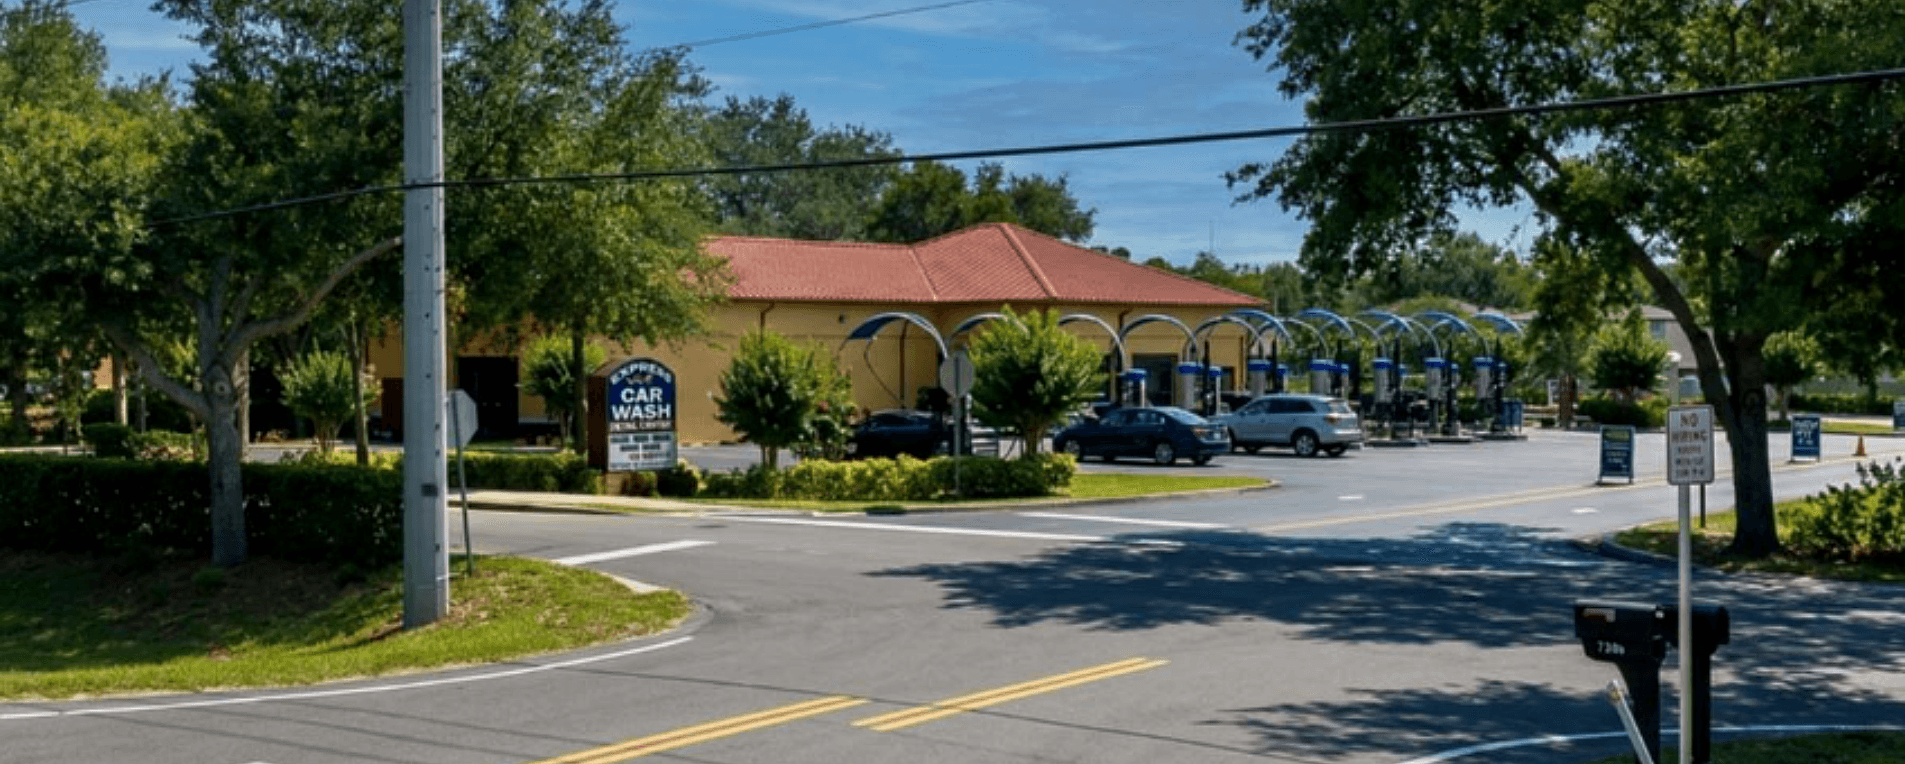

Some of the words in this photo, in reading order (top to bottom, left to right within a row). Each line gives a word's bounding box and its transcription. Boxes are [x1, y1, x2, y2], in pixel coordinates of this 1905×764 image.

[610, 361, 672, 385] EXPRESS
[620, 387, 663, 403] CAR
[611, 404, 671, 420] WASH
